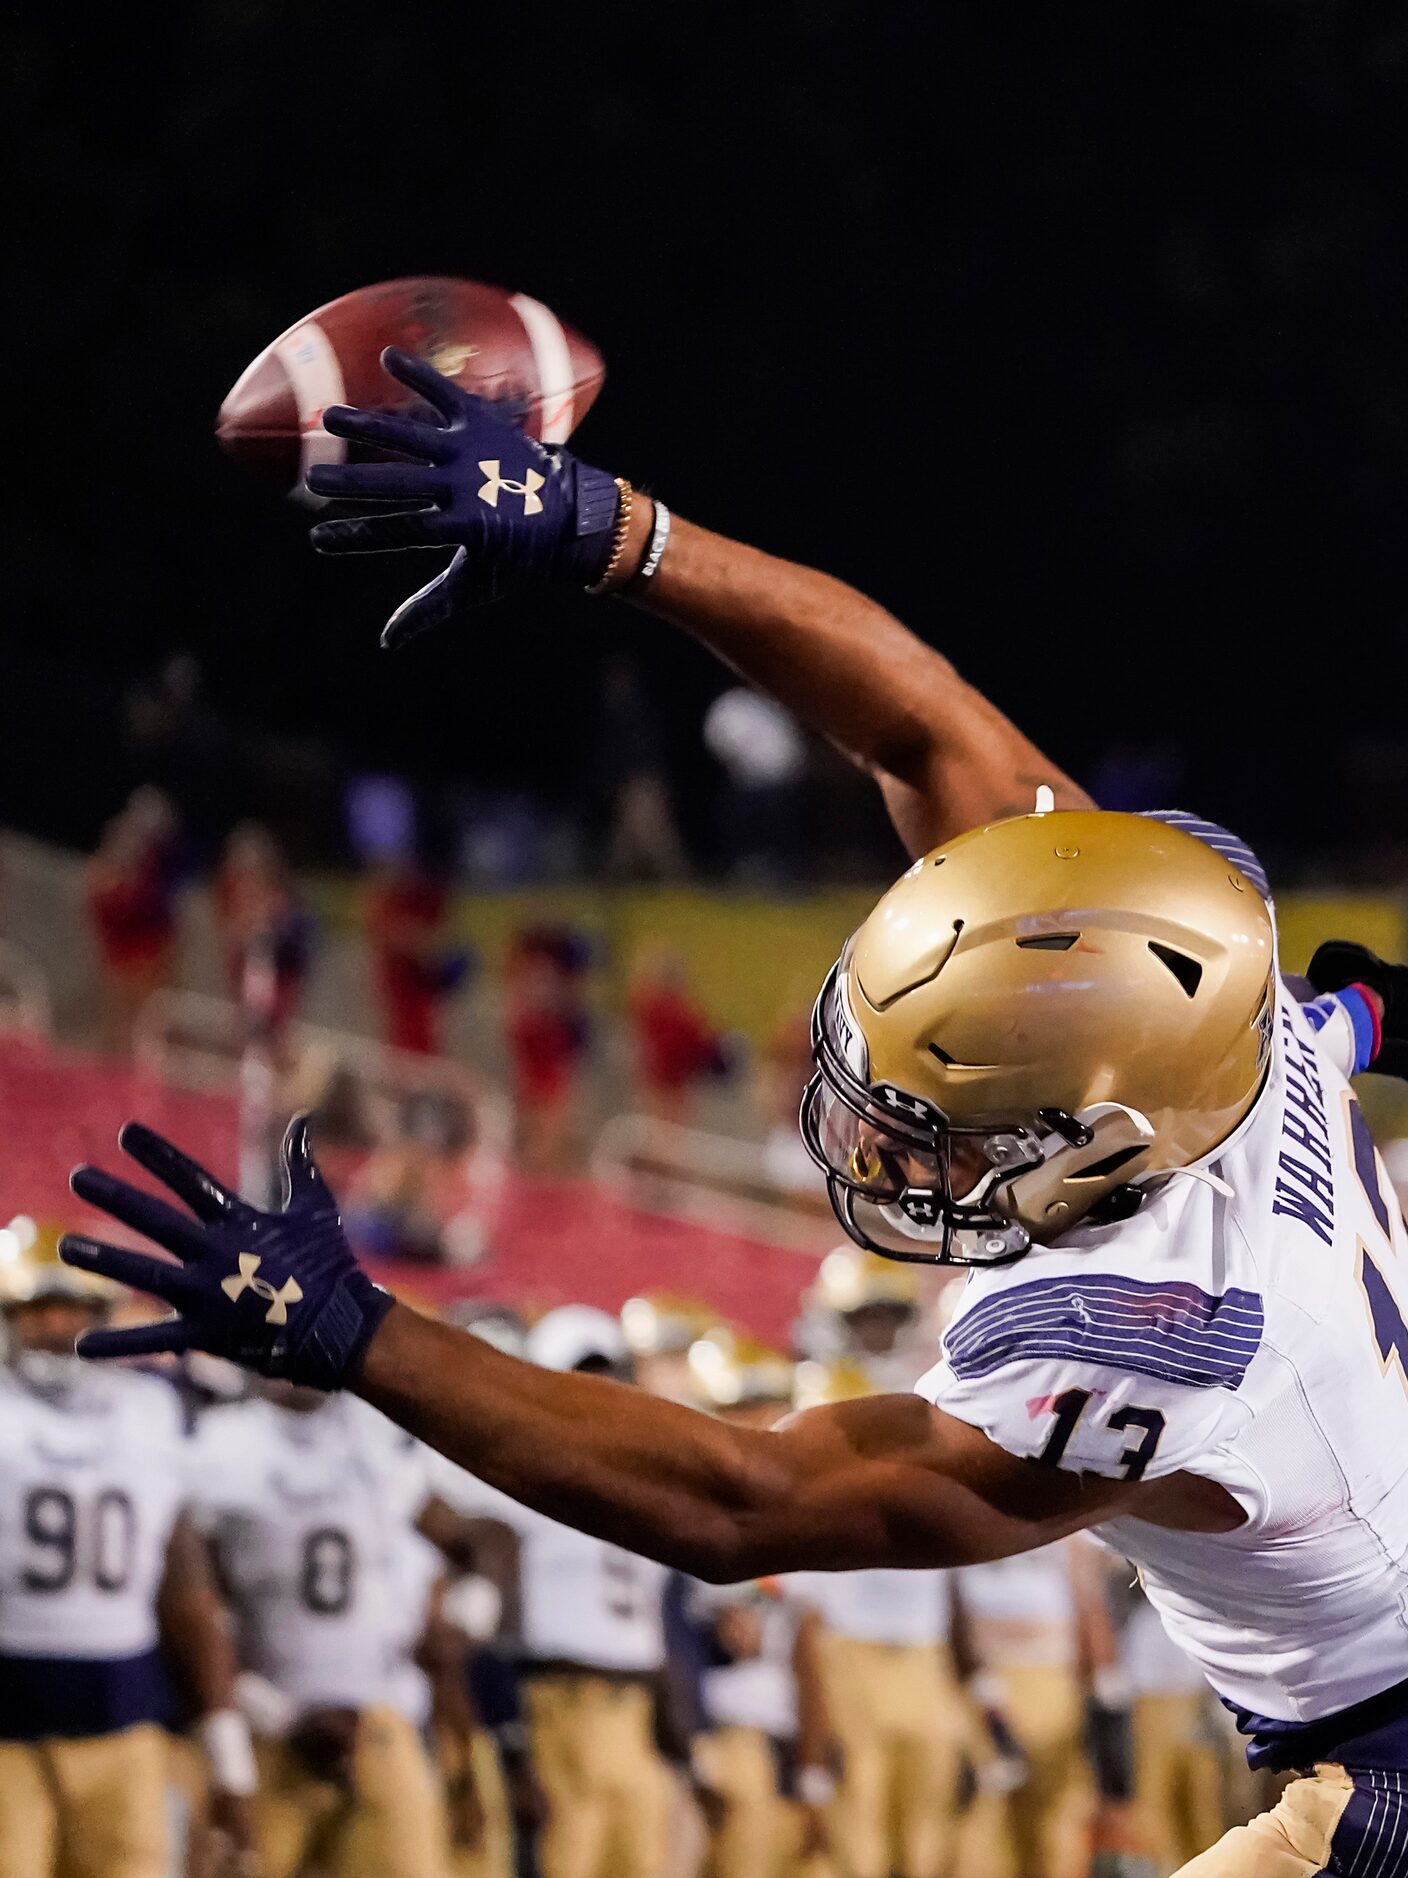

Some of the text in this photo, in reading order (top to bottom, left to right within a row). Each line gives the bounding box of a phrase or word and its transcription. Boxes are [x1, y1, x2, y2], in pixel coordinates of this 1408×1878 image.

[1271, 1004, 1335, 1248] WARREN
[1040, 1386, 1168, 1482] 13
[22, 1487, 135, 1592] 90
